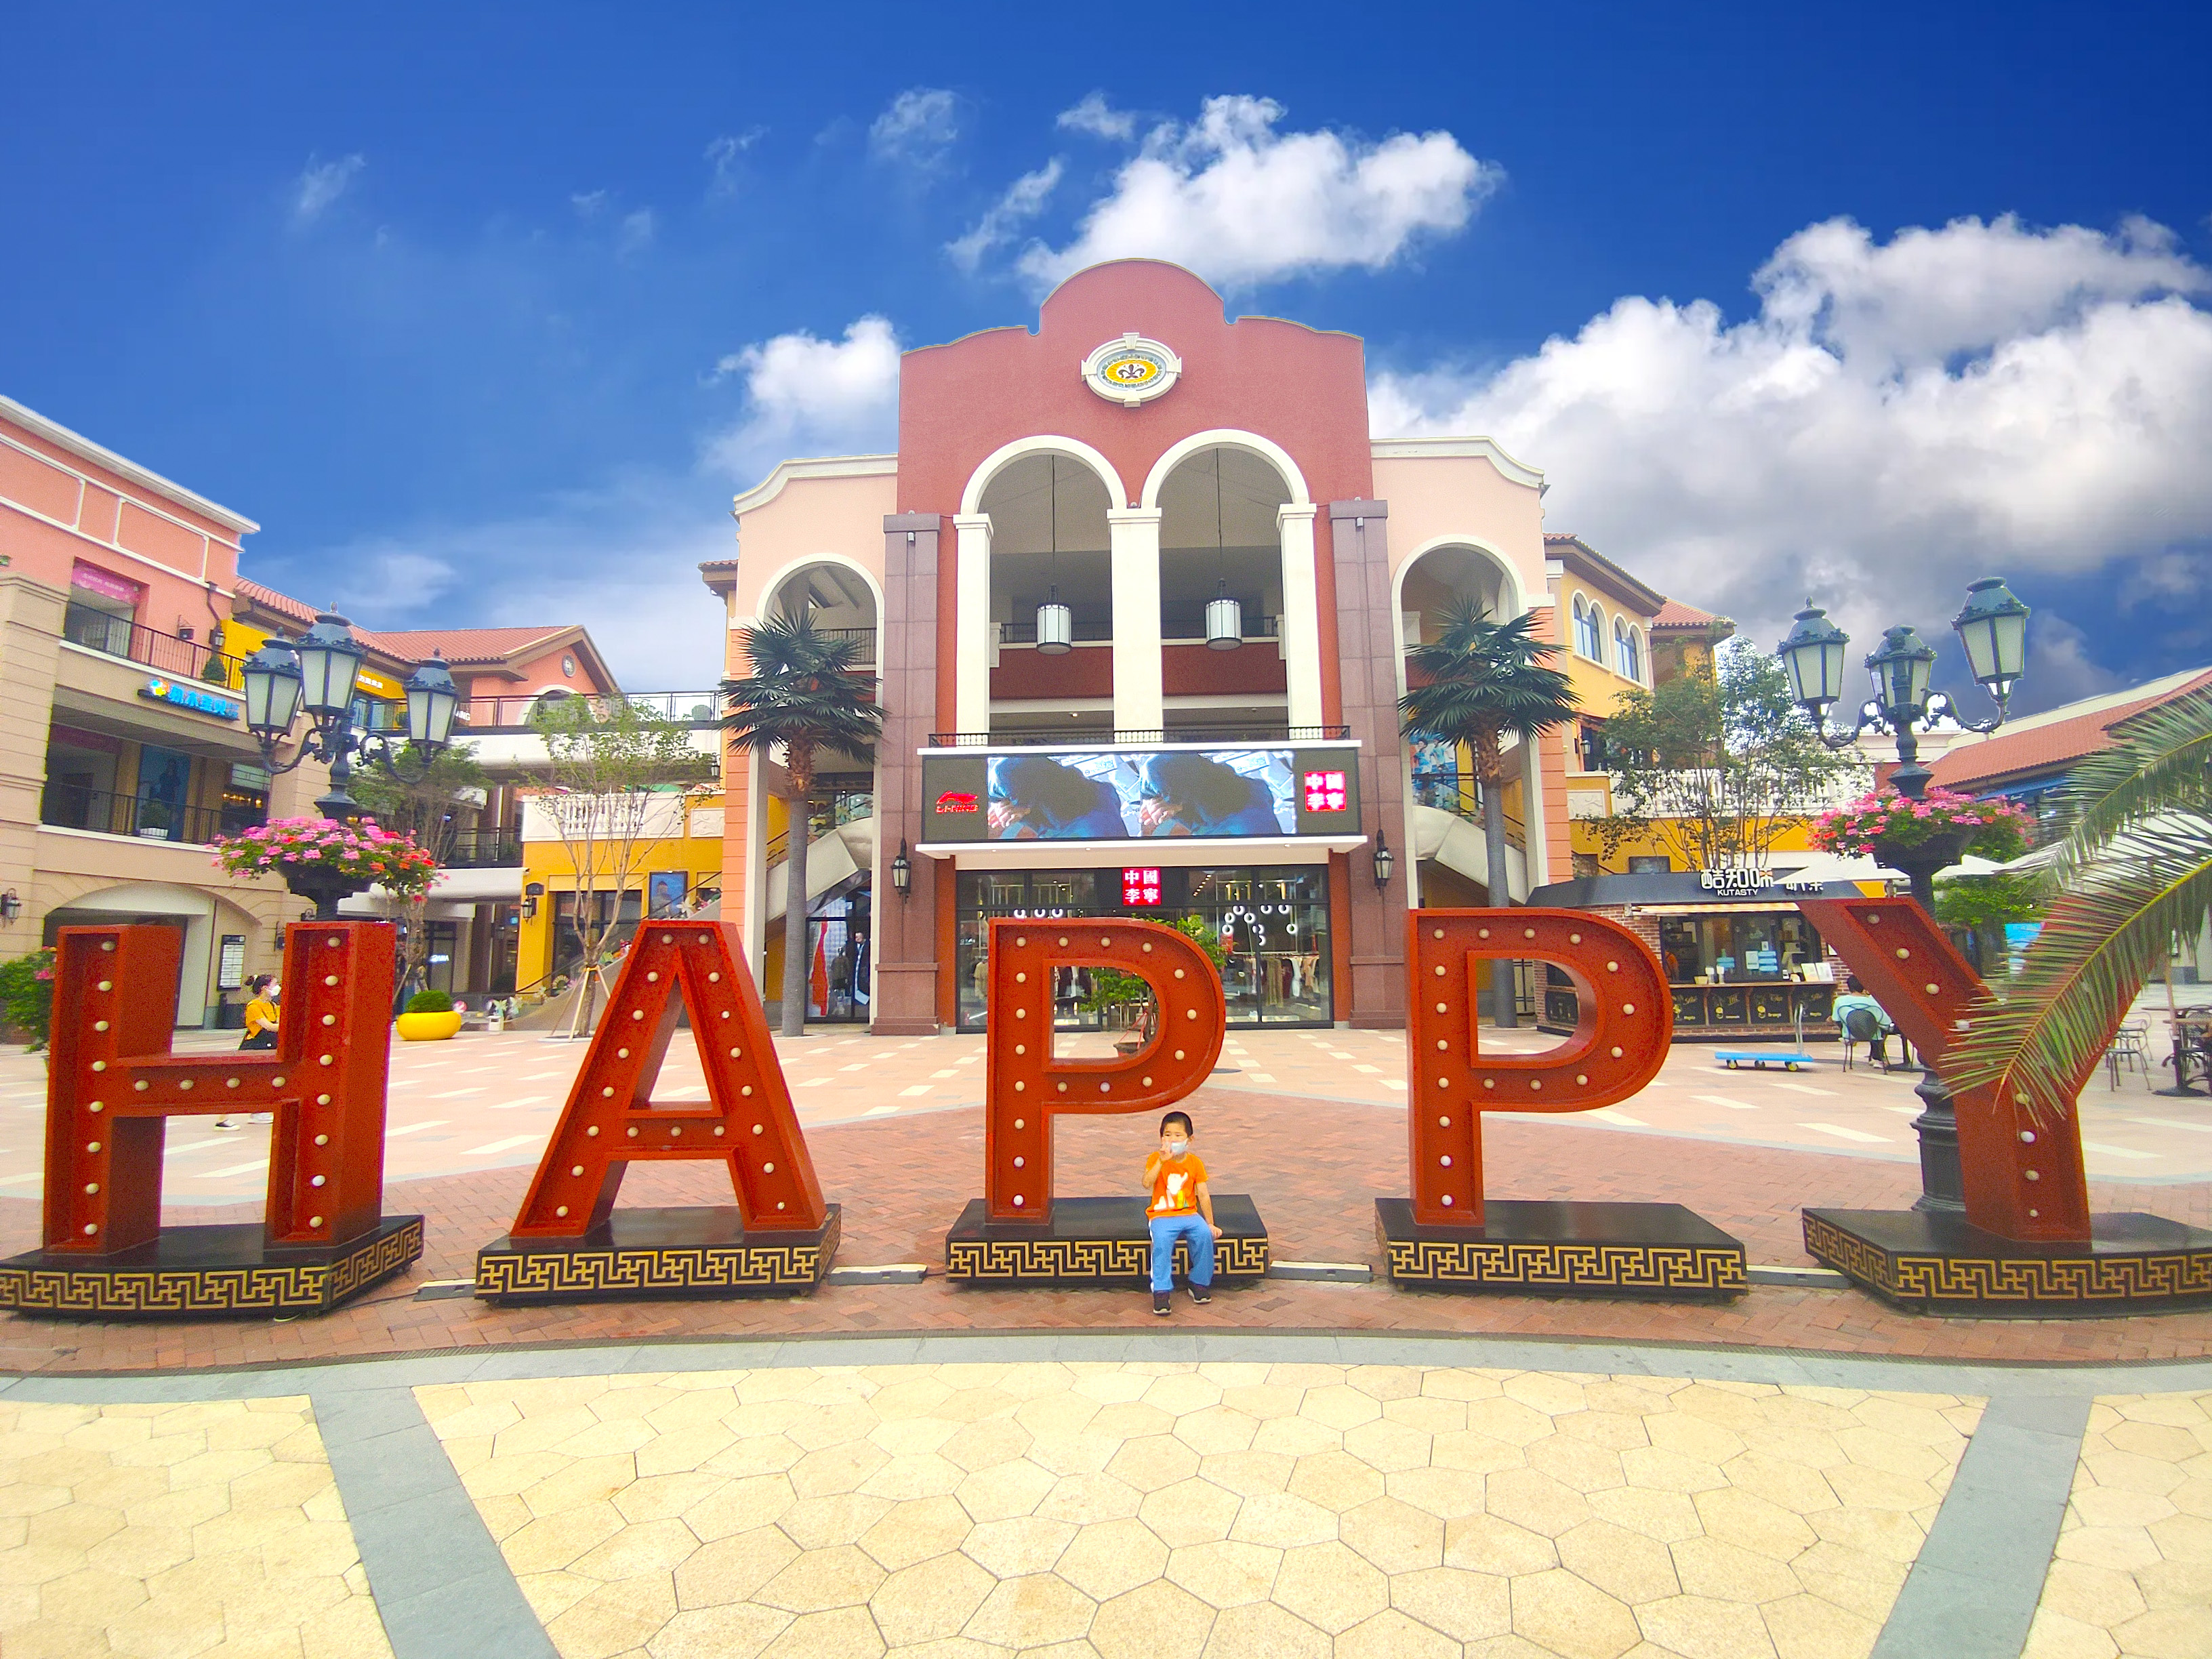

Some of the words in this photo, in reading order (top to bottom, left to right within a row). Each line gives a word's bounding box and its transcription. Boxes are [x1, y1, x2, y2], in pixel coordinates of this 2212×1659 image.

[1124, 869, 1158, 884] 中國
[1124, 887, 1158, 903] 李寧
[1717, 888, 1759, 897] KUTASTY
[42, 891, 2165, 1254] HAPPY
